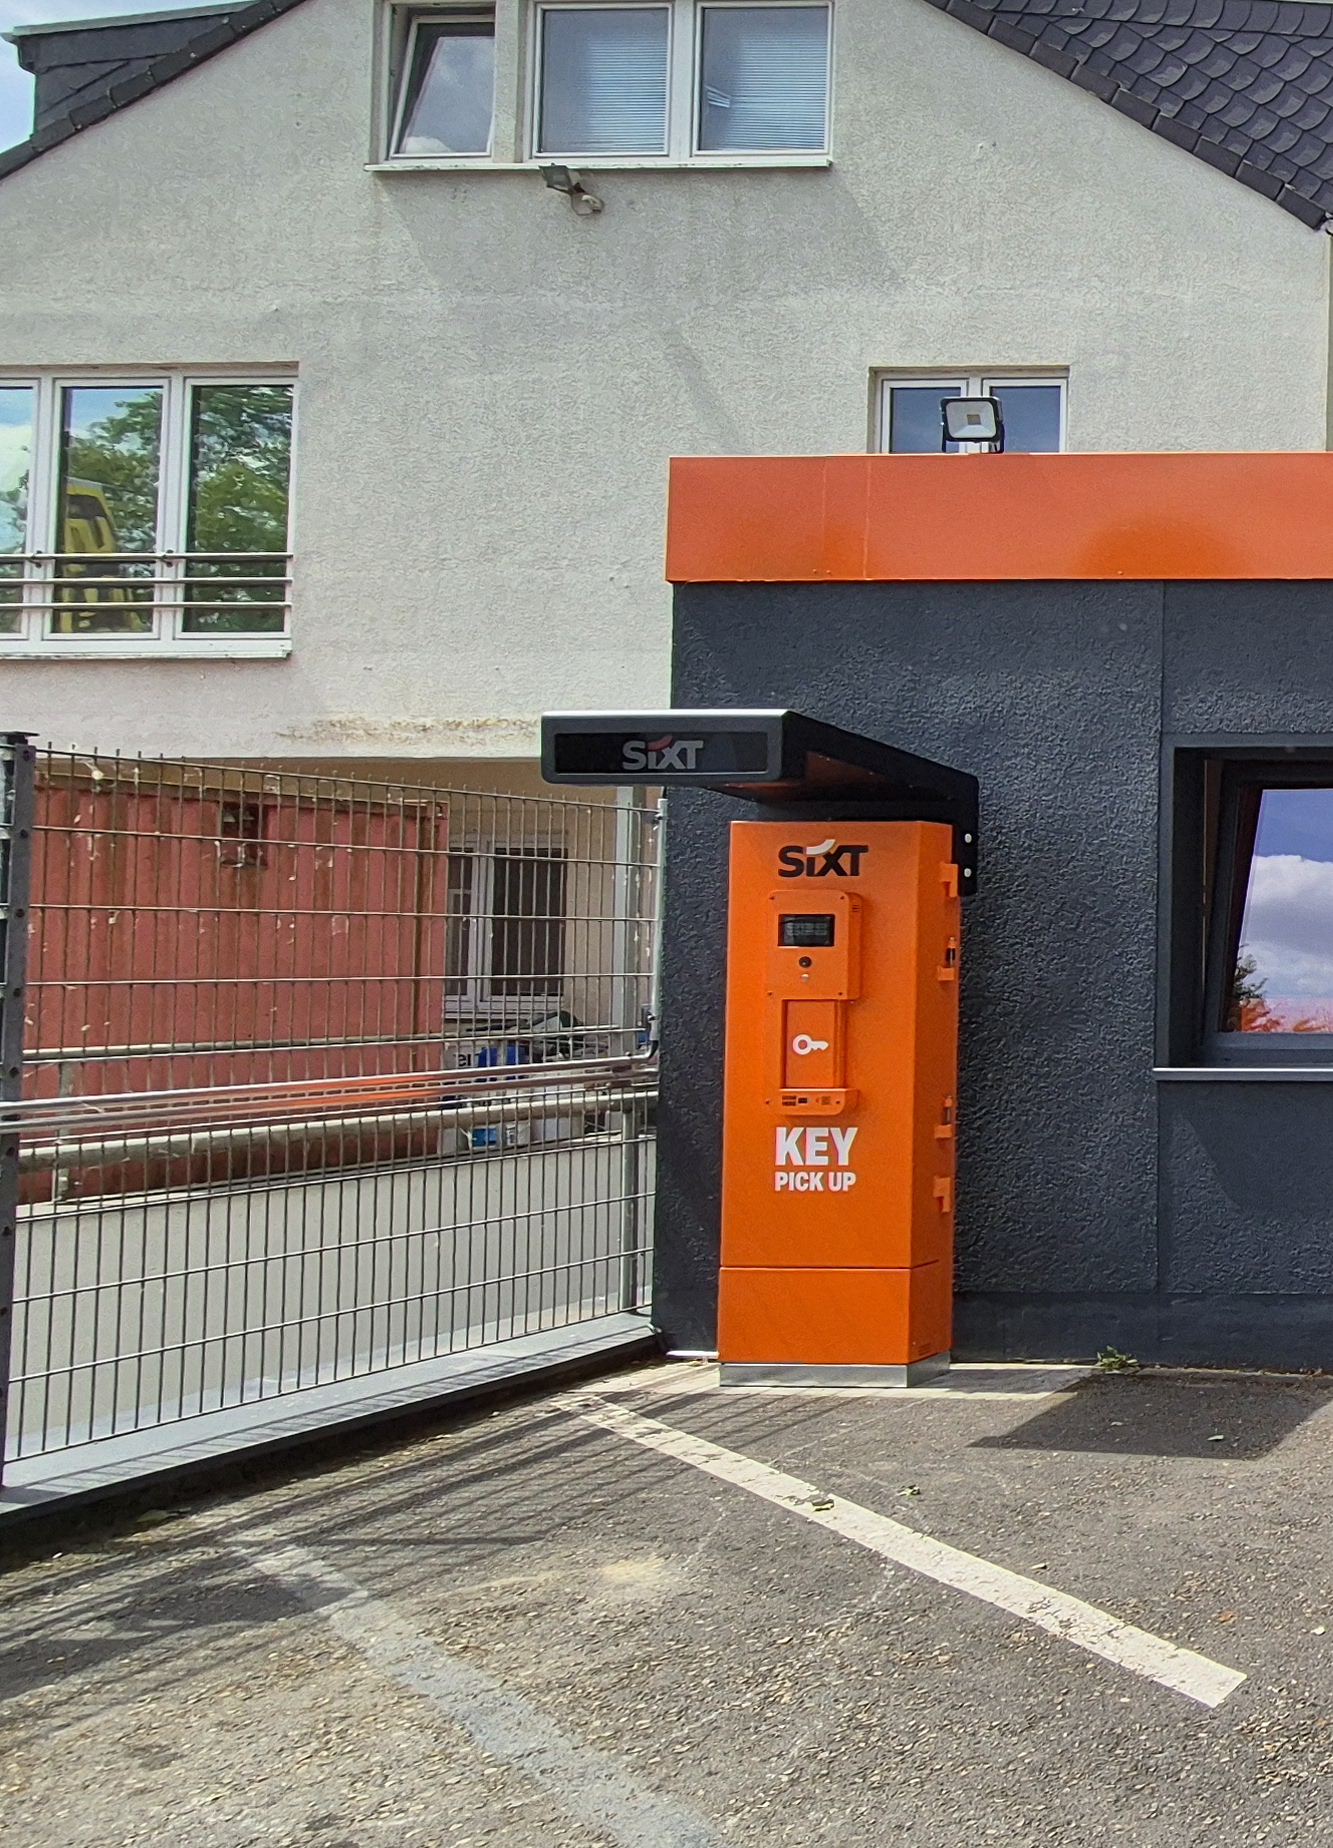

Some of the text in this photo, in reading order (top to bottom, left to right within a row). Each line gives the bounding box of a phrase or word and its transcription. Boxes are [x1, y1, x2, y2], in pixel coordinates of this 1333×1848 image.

[622, 735, 704, 771] SIXT
[778, 839, 869, 878] SIXT
[775, 1126, 859, 1166] KEY
[775, 1171, 857, 1192] PICK UP
